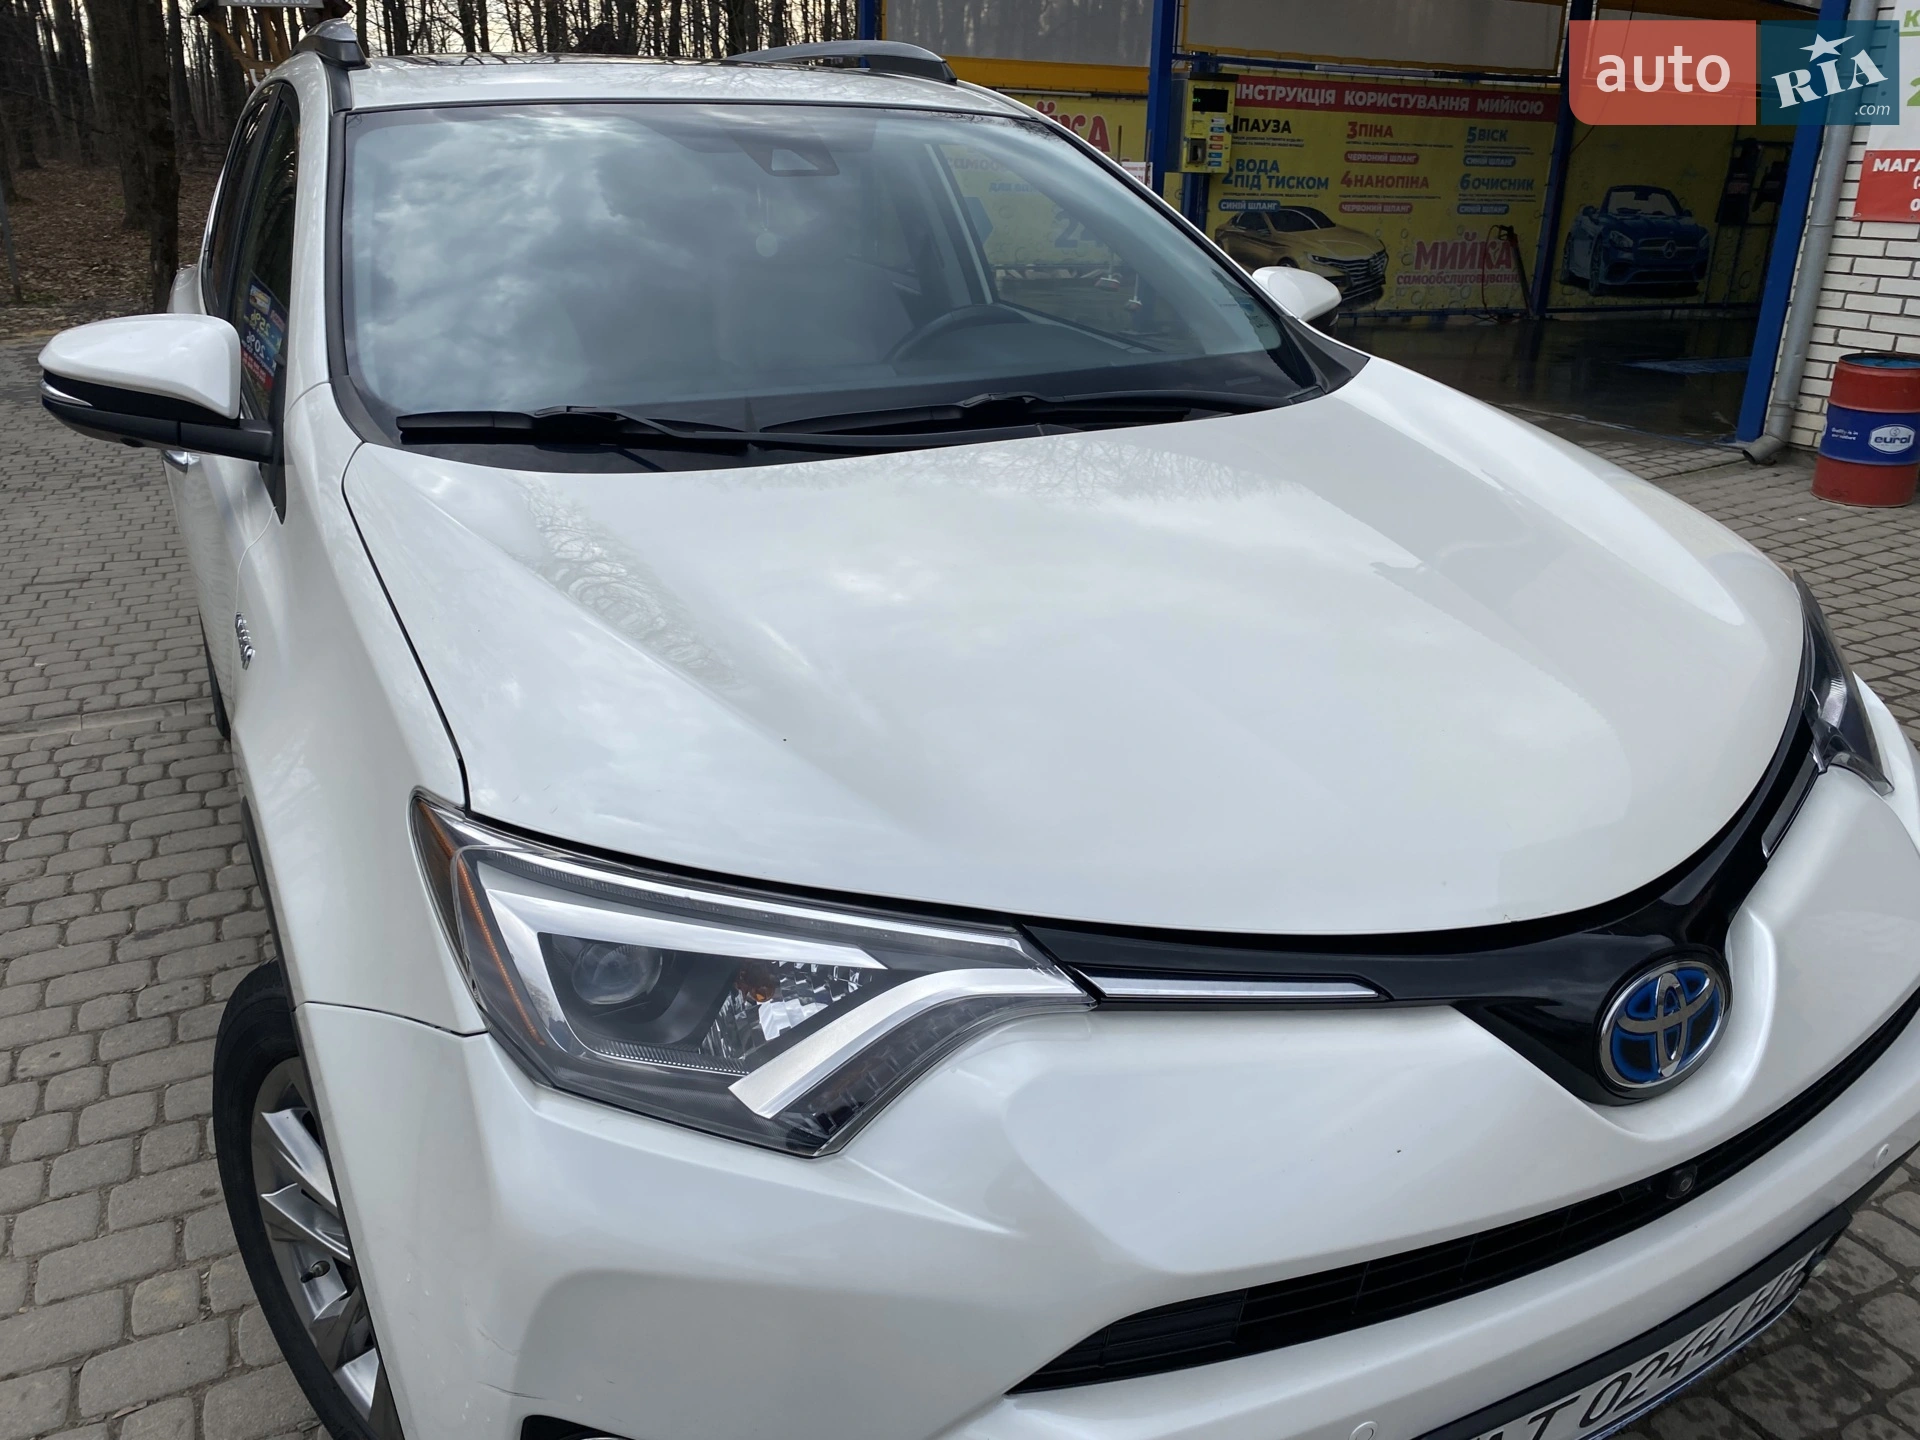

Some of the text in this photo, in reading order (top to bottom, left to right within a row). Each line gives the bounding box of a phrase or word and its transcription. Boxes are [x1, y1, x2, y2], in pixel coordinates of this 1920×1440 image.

[1236, 83, 1544, 115] ІНСТРУКЦІЯ КОРИСТУВАННЯ МИЙКОЮ
[1235, 158, 1280, 175] ВОДА
[1388, 154, 1417, 164] ШЛАНГ
[1266, 176, 1329, 190] ТИСКОМ
[1220, 201, 1278, 211] СИНІЙ ШЛАНГ
[1414, 231, 1513, 270] МИЙКА
[1396, 271, 1521, 287] самообслуговуванн
[1874, 434, 1912, 444] eurol
[1579, 1305, 1741, 1429] 0244
